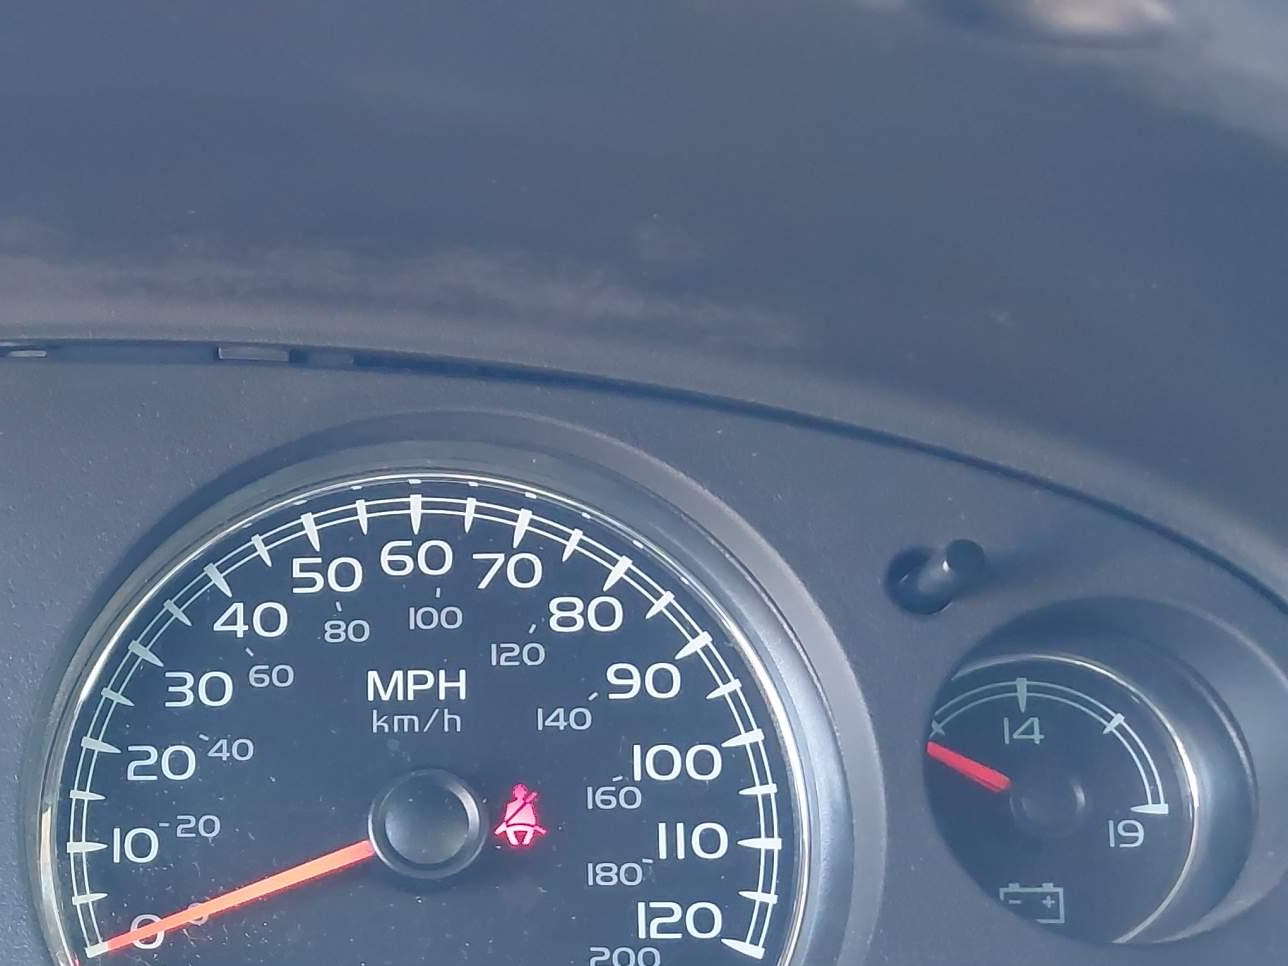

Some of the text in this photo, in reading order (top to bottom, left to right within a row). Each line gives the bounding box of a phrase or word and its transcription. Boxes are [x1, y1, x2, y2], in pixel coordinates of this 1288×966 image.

[292, 556, 363, 594] 50
[380, 540, 453, 576] 60
[472, 552, 543, 589] 70
[213, 601, 288, 638] 40
[324, 619, 370, 643] 80
[409, 606, 463, 630] 100
[548, 596, 624, 633] 80
[491, 642, 546, 666] 120
[165, 671, 234, 707] 30
[248, 664, 294, 688] 60
[367, 669, 466, 702] MPH
[606, 662, 681, 700] 90
[372, 708, 461, 733] km/h
[537, 707, 592, 731] 140
[1003, 716, 1045, 745] 14
[127, 745, 196, 781] 20
[208, 738, 254, 761] 40
[633, 744, 722, 782] 100
[586, 786, 642, 810] 160
[176, 814, 221, 841] 20
[658, 822, 729, 860] 110
[1108, 819, 1145, 848] 19
[113, 827, 159, 864] 10
[587, 862, 643, 886] 180
[130, 913, 165, 950] 0
[637, 901, 723, 939] 120
